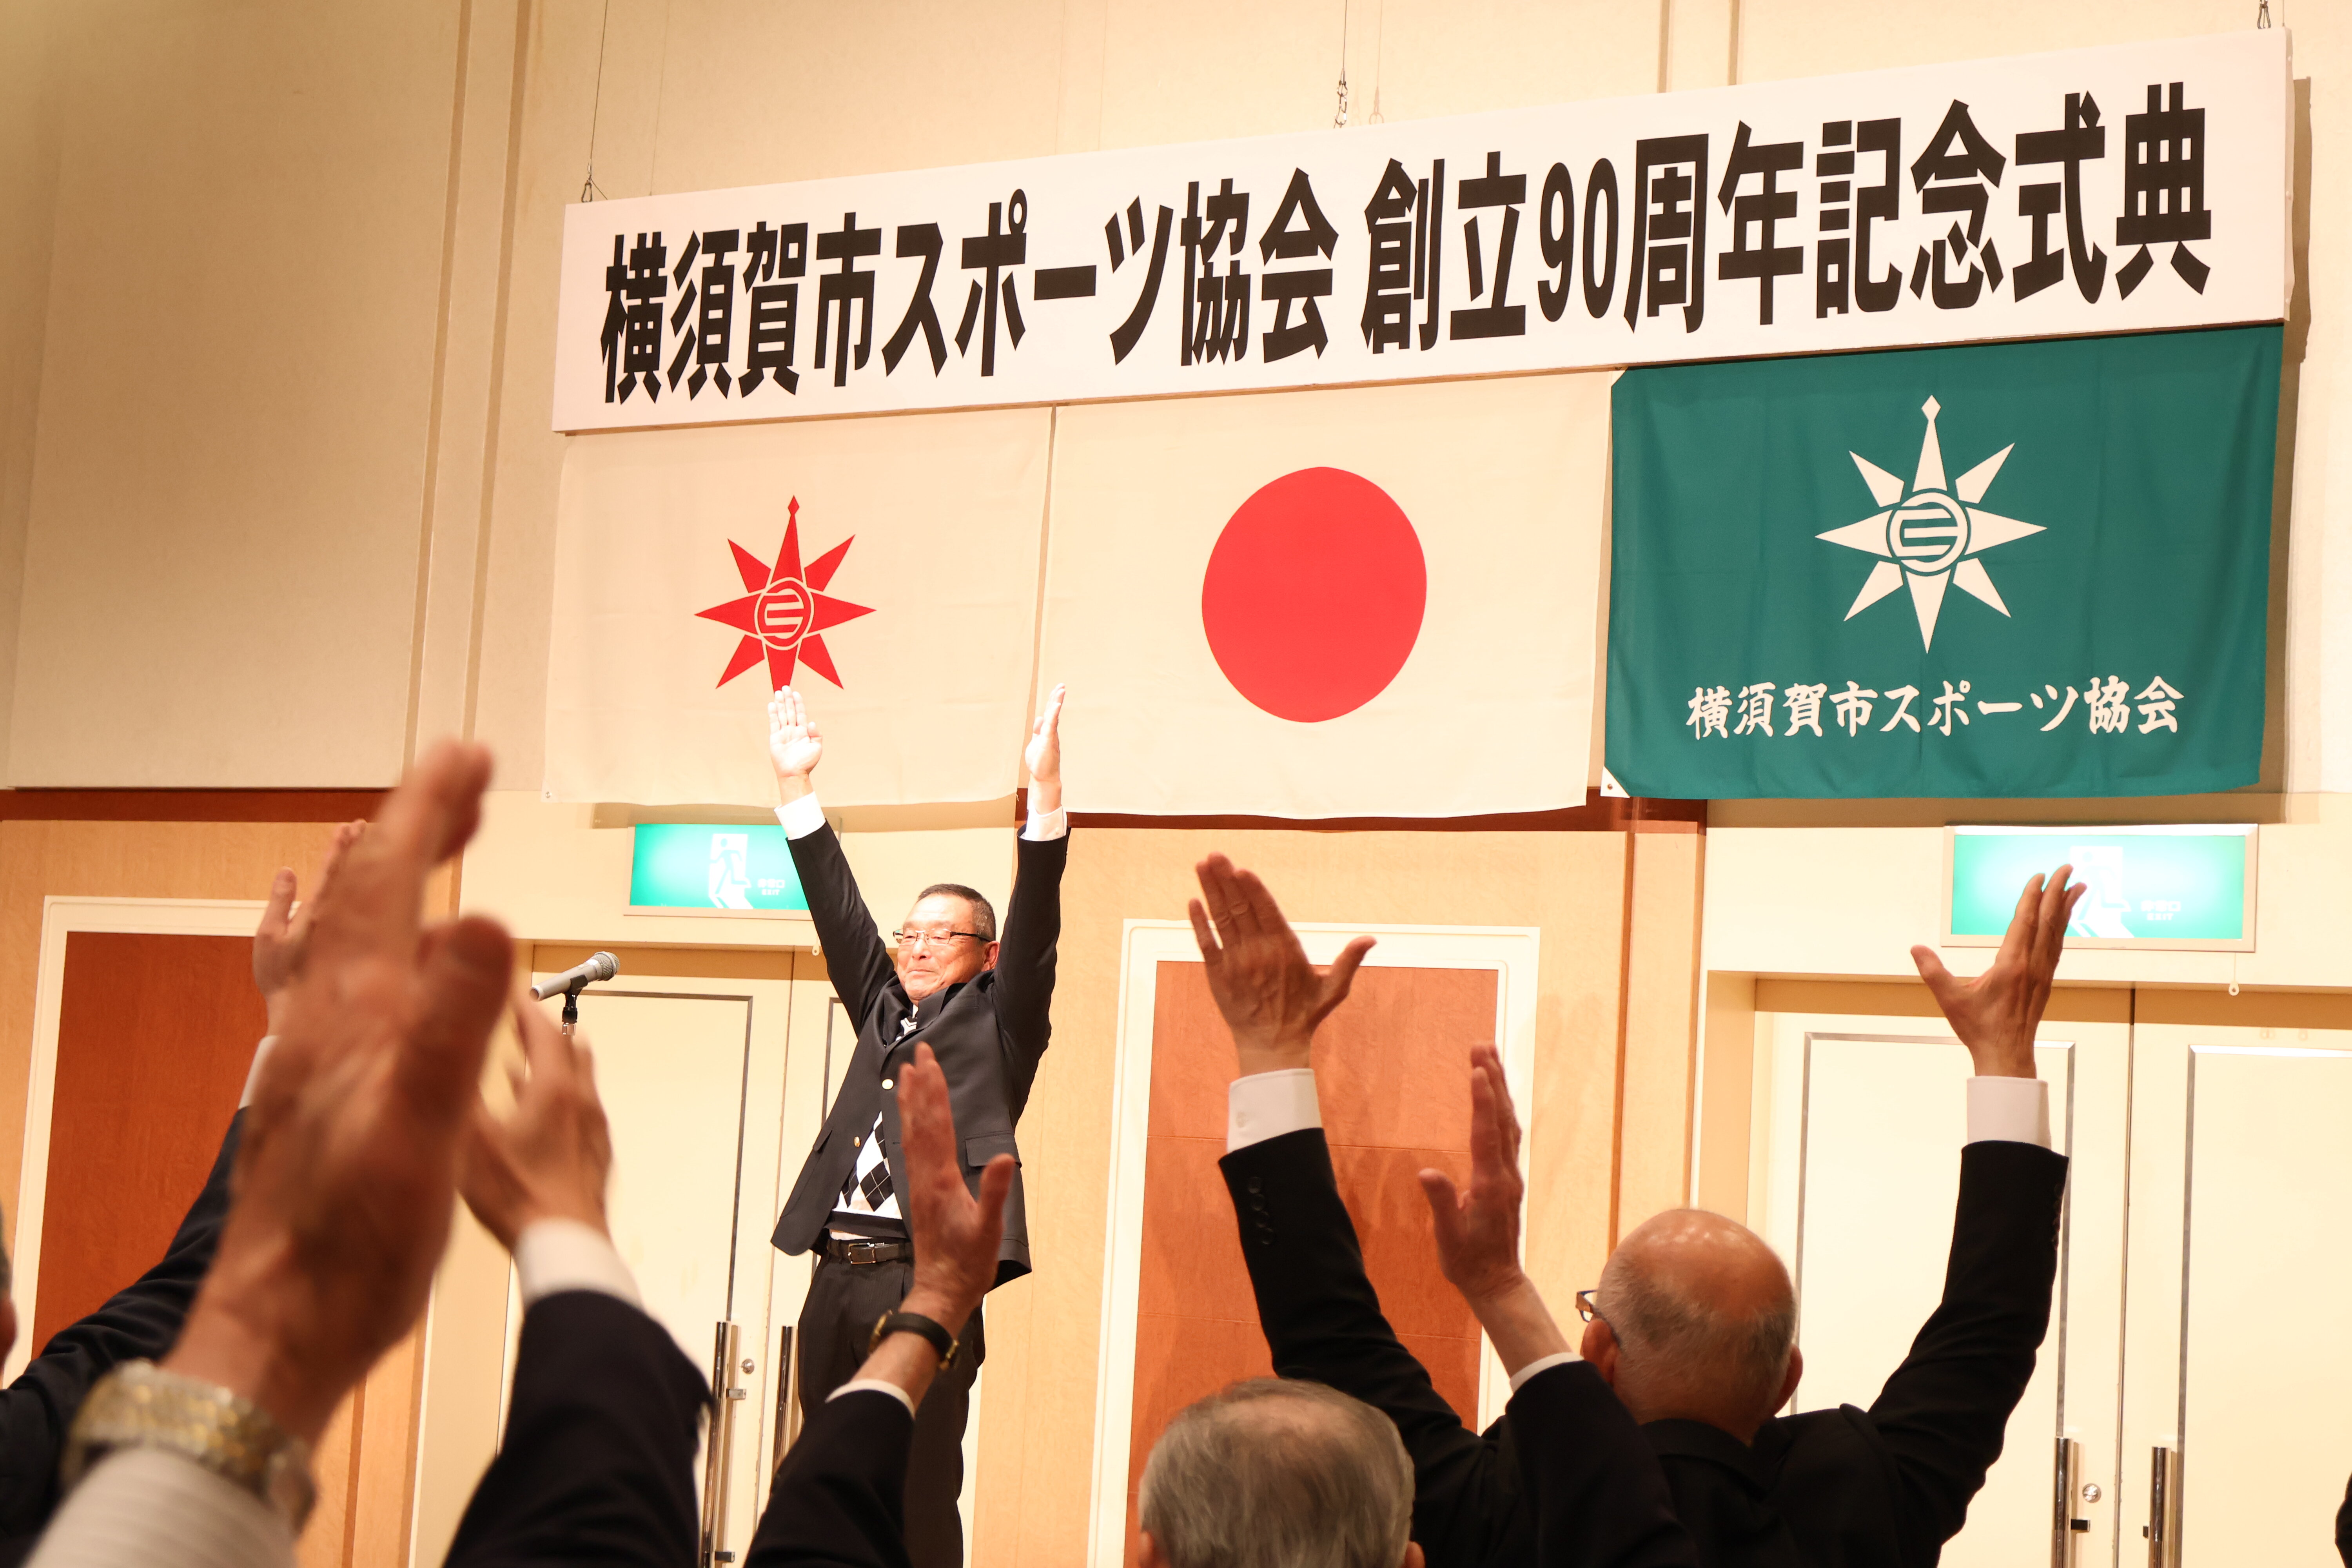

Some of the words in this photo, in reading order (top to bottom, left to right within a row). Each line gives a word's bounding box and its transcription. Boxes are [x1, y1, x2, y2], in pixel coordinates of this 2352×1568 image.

[601, 168, 1338, 405] 横須賀市スポーツ協会
[1361, 82, 2211, 354] 創立90周年記念式典
[1686, 675, 2184, 740] 横須賀市スポーツ協会
